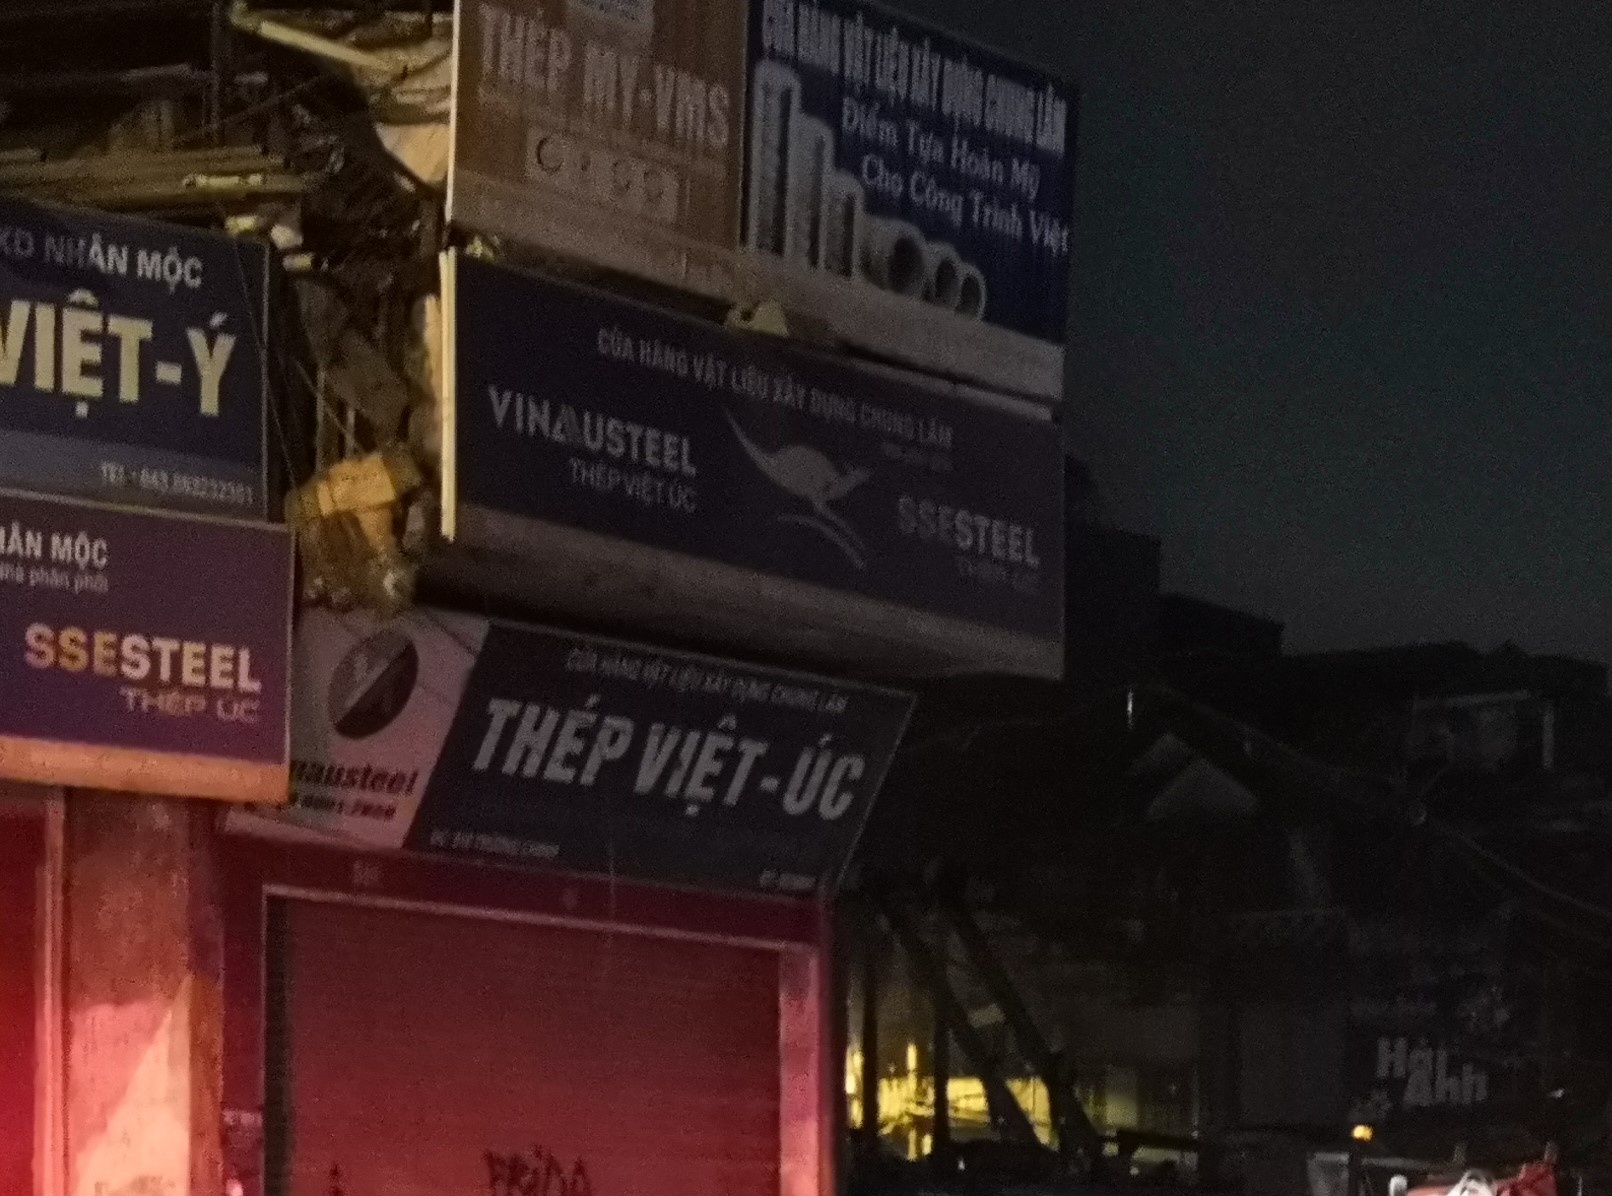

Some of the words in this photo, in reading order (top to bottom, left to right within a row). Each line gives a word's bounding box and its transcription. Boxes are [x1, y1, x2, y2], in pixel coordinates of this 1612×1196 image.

[862, 153, 904, 199] Cho
[137, 246, 204, 294] MỘC
[487, 385, 698, 478] VINAUSTEEL
[51, 531, 108, 571] MỘC
[897, 494, 1041, 569] SSESTEEL
[24, 622, 262, 693] SSESTEEL
[471, 692, 636, 787] THÉP
